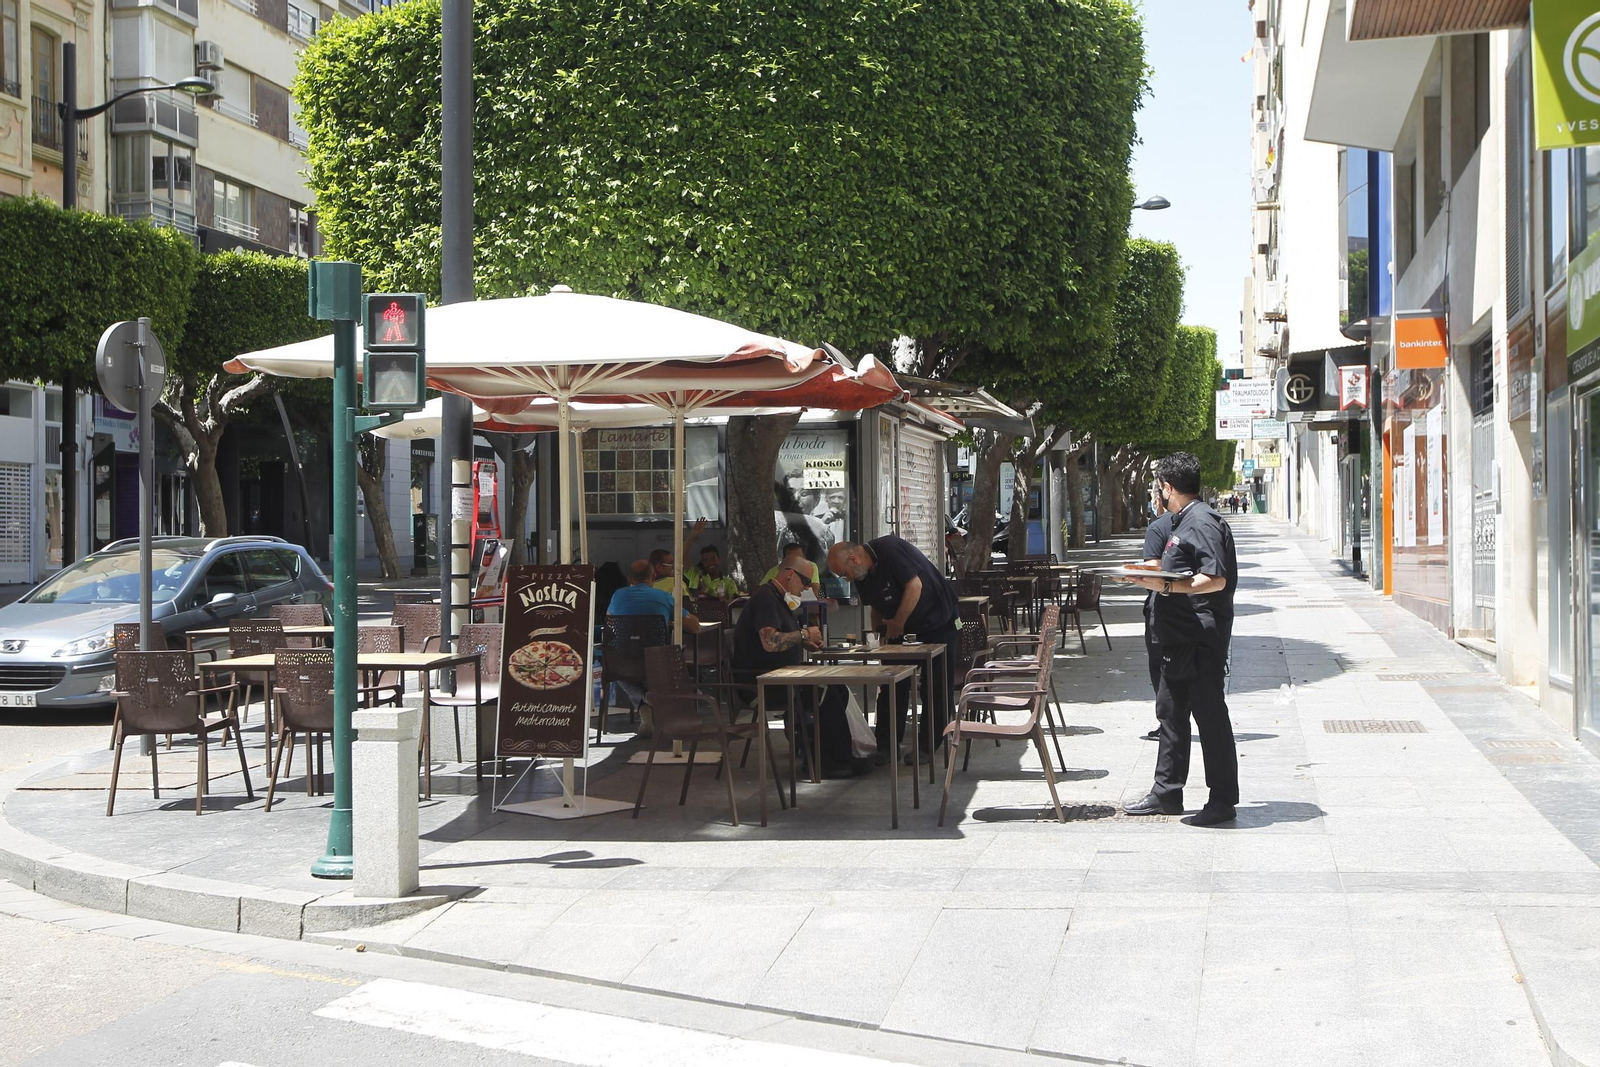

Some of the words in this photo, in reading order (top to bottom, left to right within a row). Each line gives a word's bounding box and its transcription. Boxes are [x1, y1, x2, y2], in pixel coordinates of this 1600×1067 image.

[1556, 119, 1599, 133] YVES
[600, 429, 669, 443] Lamarté
[793, 436, 826, 450] boda
[784, 452, 803, 461] rojas
[805, 460, 843, 468] KIOSKO
[808, 480, 841, 488] VENTA
[519, 583, 577, 609] Nostra
[15, 695, 33, 706] DLR
[515, 713, 570, 727] Mediterránea
